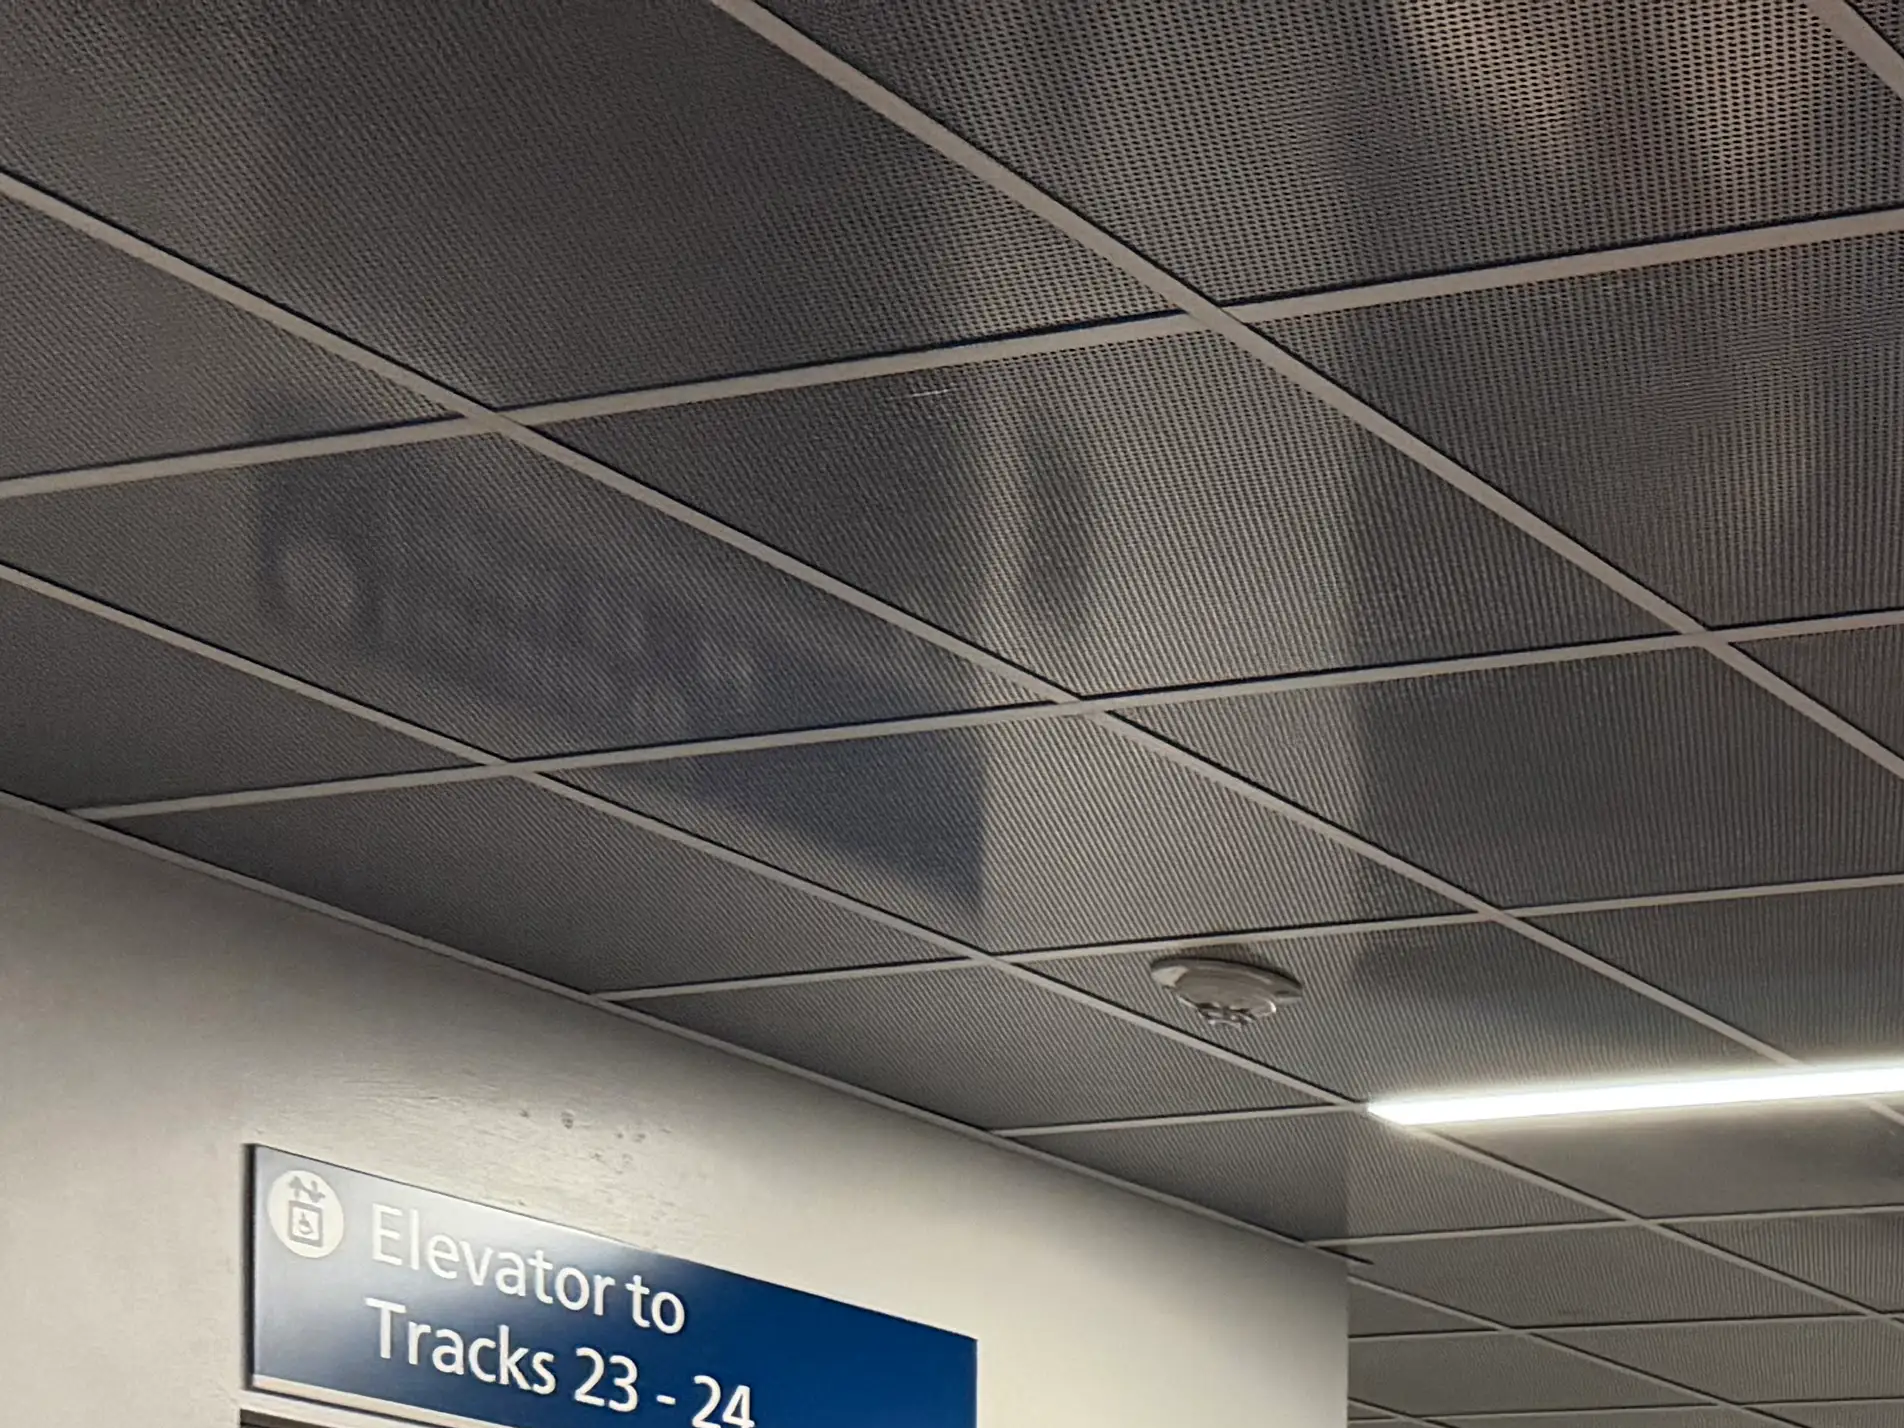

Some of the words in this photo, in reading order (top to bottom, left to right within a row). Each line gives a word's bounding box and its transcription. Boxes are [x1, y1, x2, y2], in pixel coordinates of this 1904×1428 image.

[371, 1203, 615, 1316] Elevator
[624, 1275, 686, 1334] to
[366, 1297, 557, 1395] Tracks
[574, 1347, 639, 1412] 23
